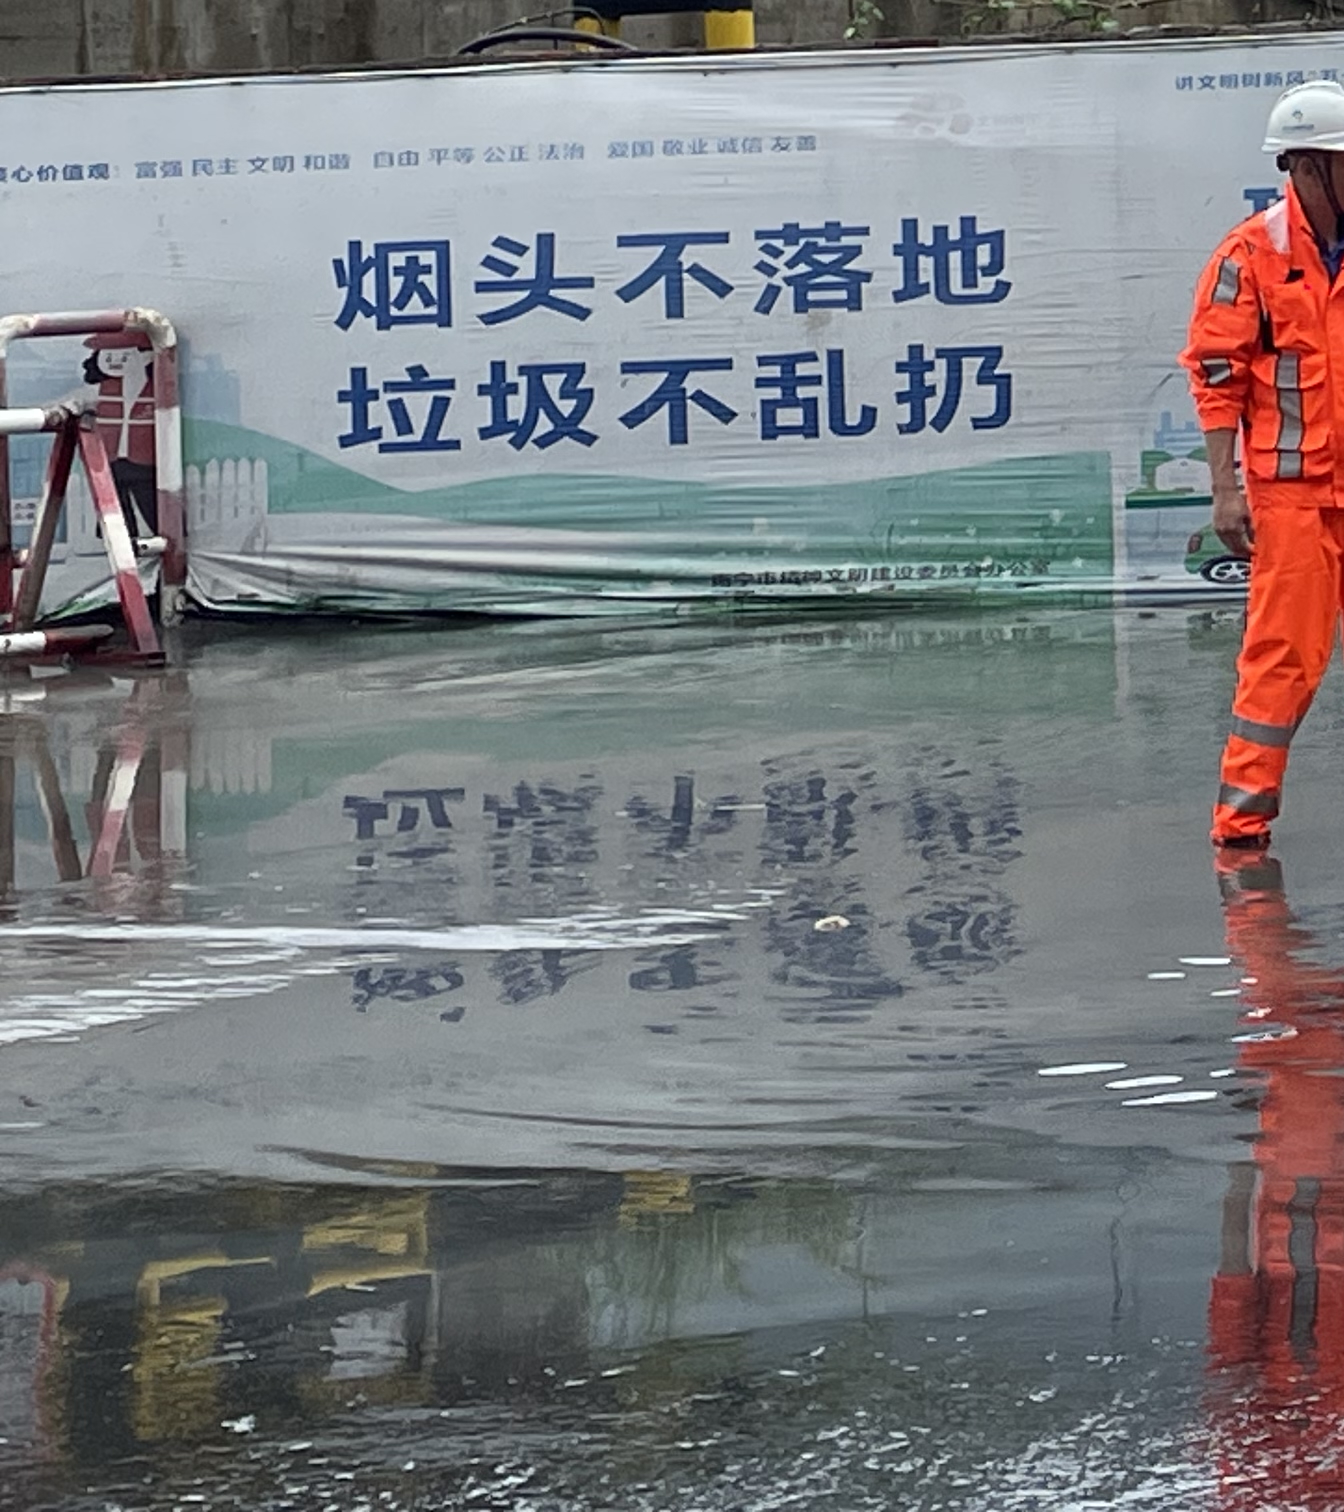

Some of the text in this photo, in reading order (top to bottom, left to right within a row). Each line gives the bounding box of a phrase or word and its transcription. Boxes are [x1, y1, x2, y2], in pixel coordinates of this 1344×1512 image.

[134, 159, 184, 179] 富强
[191, 156, 238, 176] 民主
[247, 153, 294, 174] 文明
[302, 151, 351, 172] 和谐
[373, 149, 420, 169] 自由
[429, 148, 475, 166] 平等
[484, 145, 529, 164] 公正
[539, 143, 585, 161] 法治
[607, 140, 654, 159] 爱国
[662, 138, 709, 157] 敬业
[716, 135, 763, 154] 诚信
[771, 134, 816, 153] 友善
[333, 216, 1012, 331] 烟头不落地
[337, 343, 1012, 454] 垃圾不乱扔
